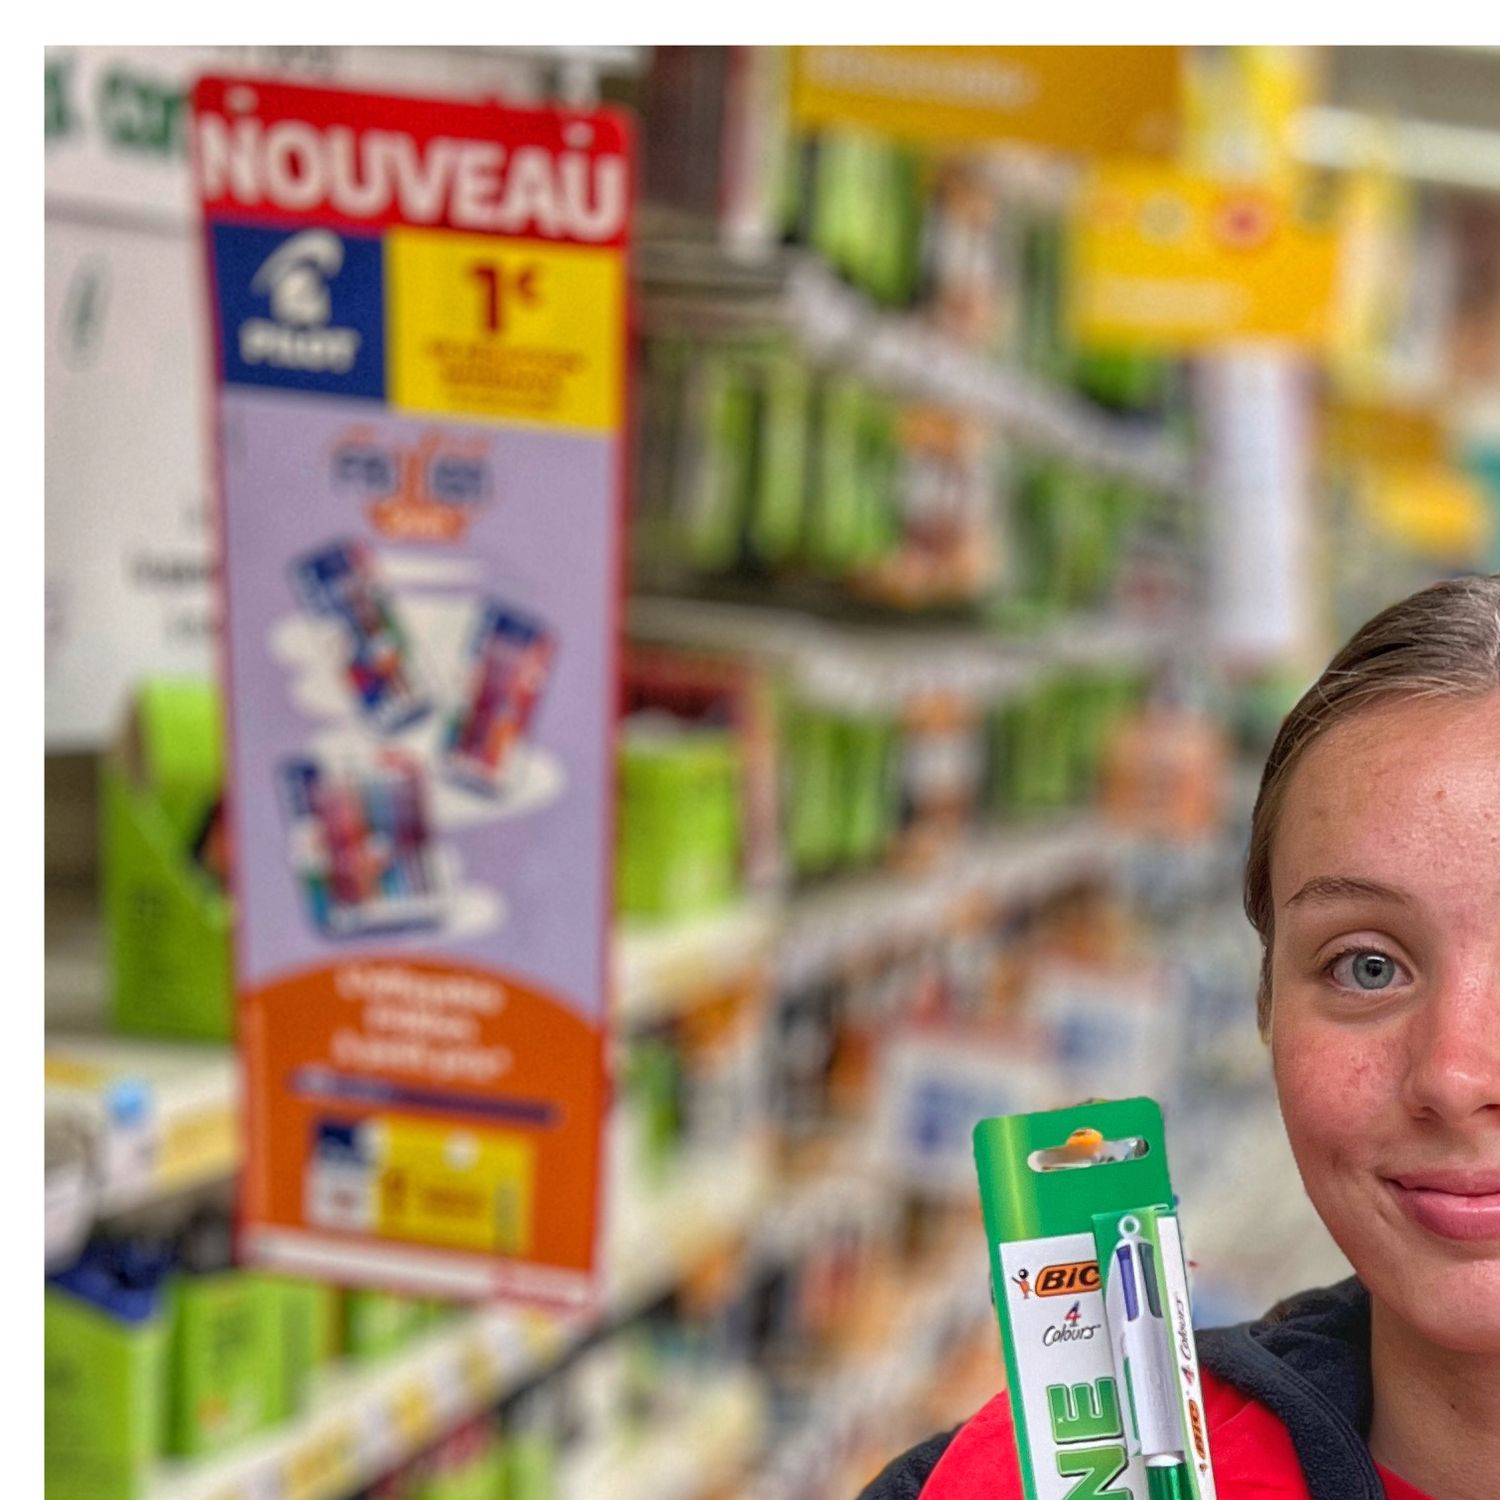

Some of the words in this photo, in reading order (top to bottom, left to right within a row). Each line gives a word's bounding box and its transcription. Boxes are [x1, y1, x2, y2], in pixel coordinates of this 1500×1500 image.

[201, 114, 623, 241] NOUVEAU
[1064, 1301, 1081, 1326] 4
[1043, 1324, 1099, 1347] Colours
